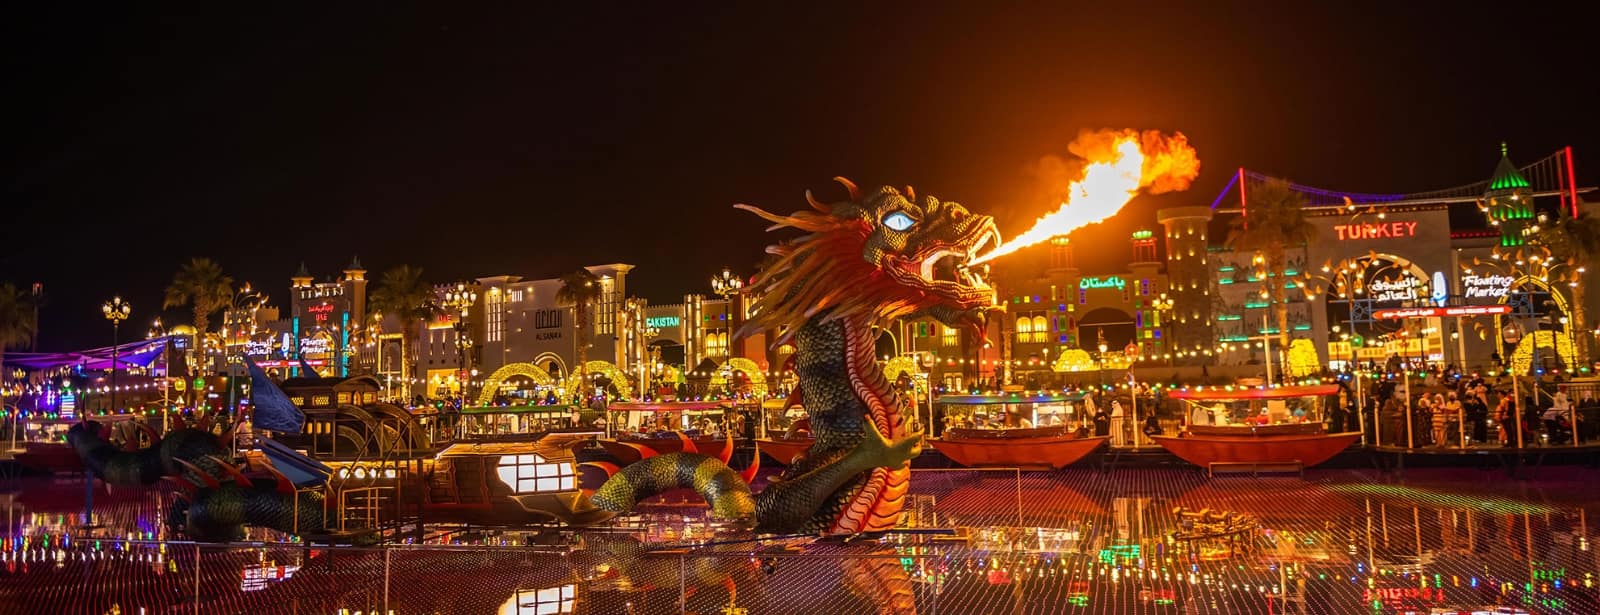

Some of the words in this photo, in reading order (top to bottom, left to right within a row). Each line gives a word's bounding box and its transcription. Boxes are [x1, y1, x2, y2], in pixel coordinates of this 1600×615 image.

[1334, 222, 1417, 240] TURKEY
[1464, 275, 1514, 287] Floating
[1465, 286, 1509, 298] Market
